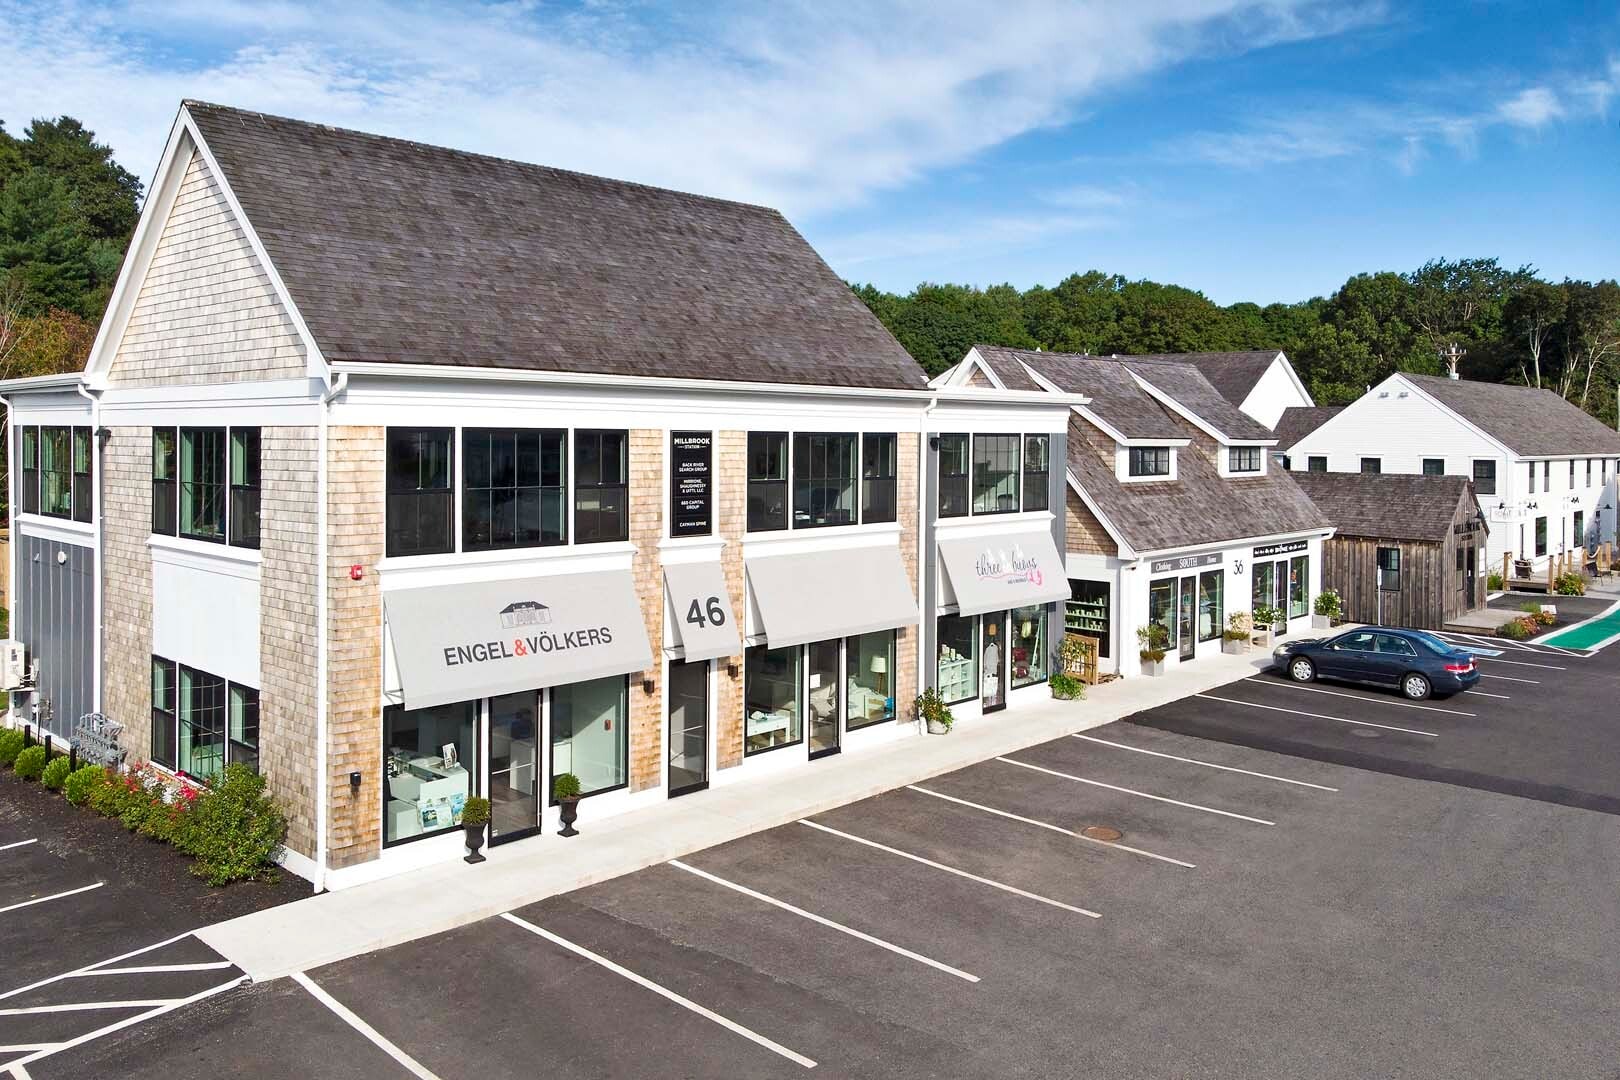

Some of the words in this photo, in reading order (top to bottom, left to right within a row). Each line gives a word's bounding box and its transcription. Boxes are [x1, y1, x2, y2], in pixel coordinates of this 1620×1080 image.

[976, 553, 1001, 576] three
[1179, 557, 1197, 568] SOUTH
[1233, 560, 1243, 575] 36
[686, 596, 725, 628] 46
